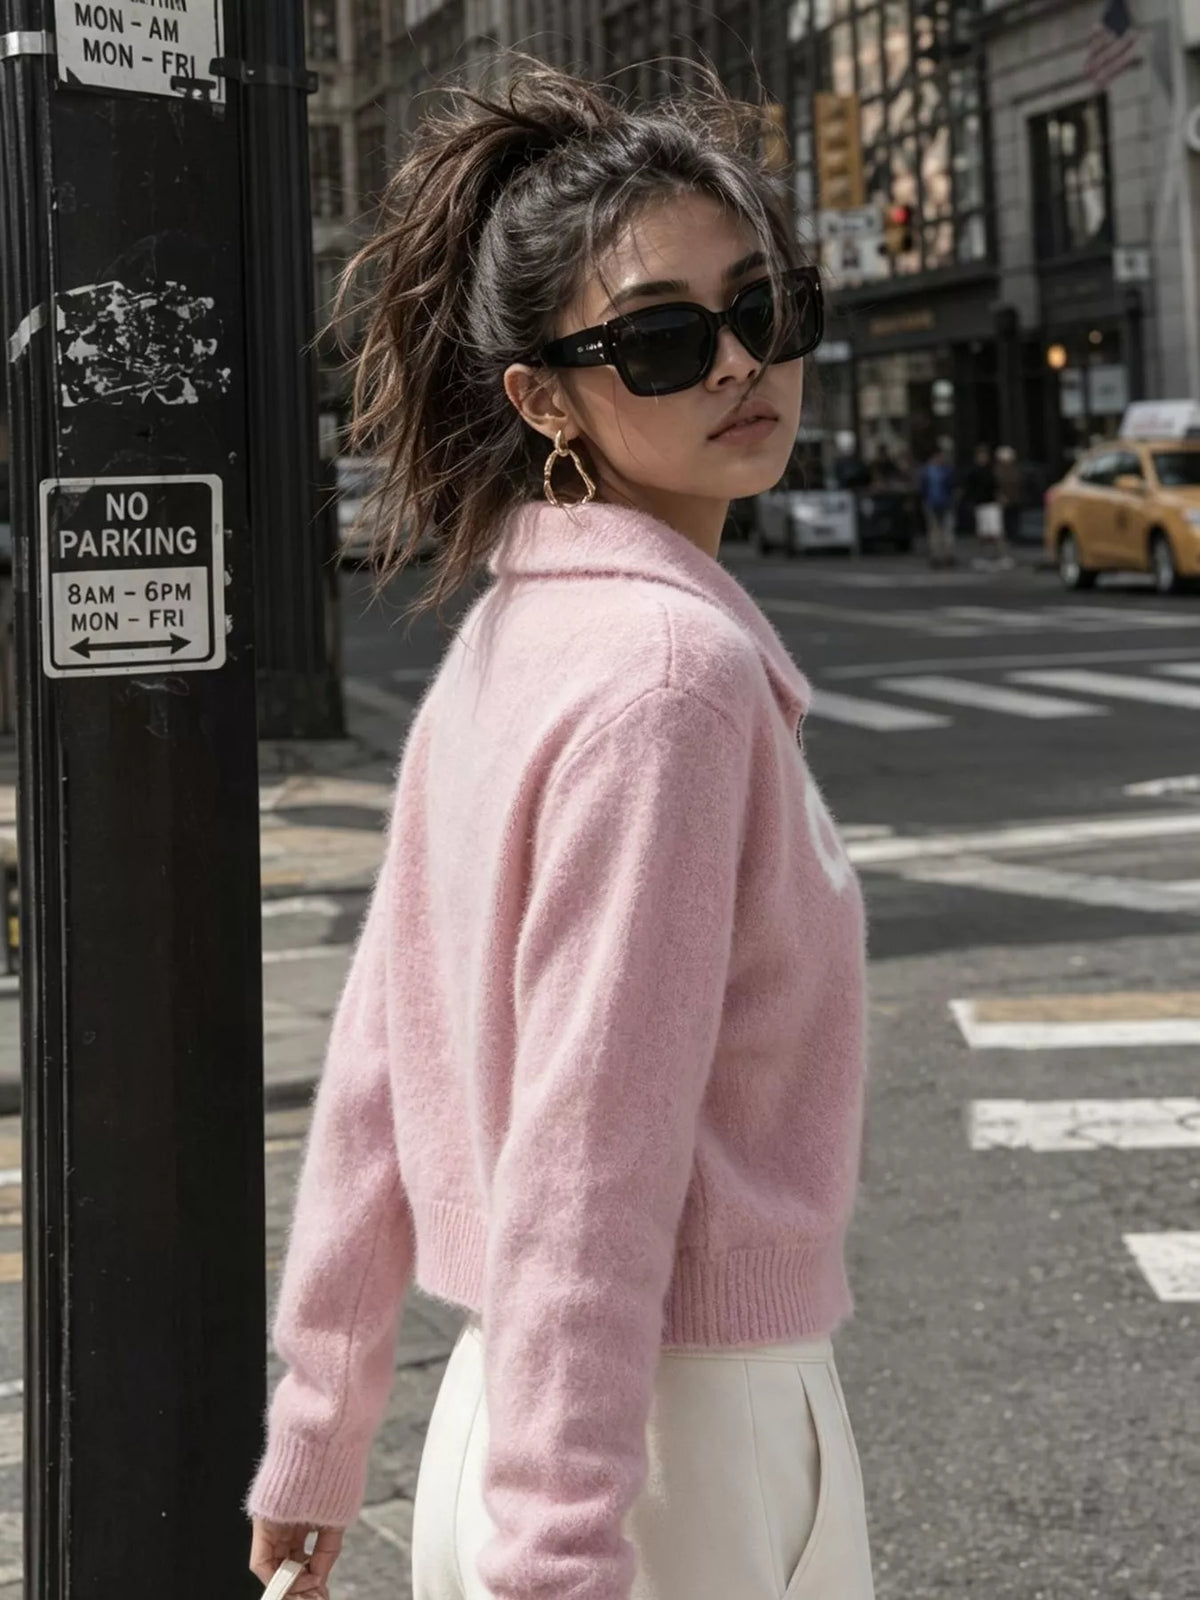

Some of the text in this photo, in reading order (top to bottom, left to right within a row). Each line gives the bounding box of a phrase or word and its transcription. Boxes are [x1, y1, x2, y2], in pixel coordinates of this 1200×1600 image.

[75, 2, 124, 33] MON
[149, 16, 179, 43] AM
[83, 37, 133, 69] MON
[162, 50, 195, 79] FRI
[106, 491, 149, 521] NO
[59, 526, 197, 559] PARKING
[68, 583, 115, 605] 8AM
[145, 581, 191, 602] 6PM
[71, 612, 119, 632] MON
[149, 609, 184, 629] FRI
